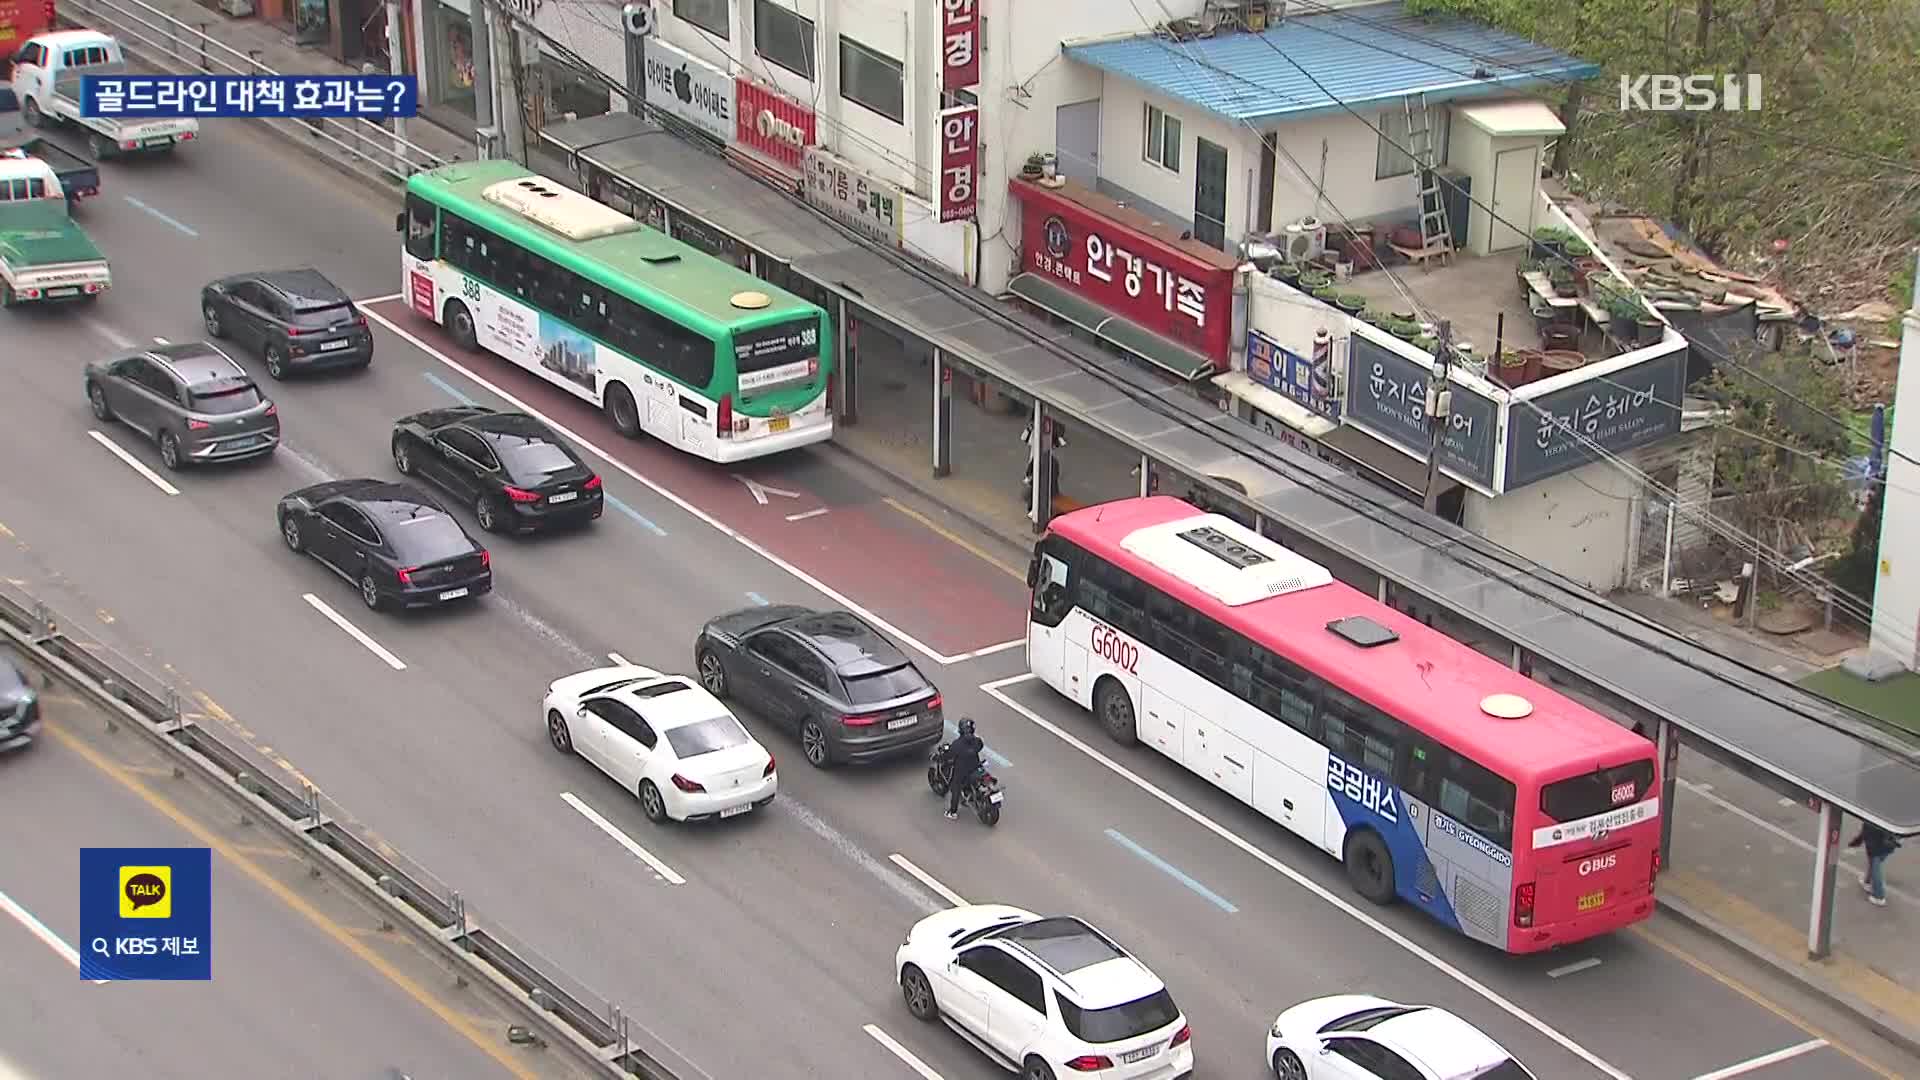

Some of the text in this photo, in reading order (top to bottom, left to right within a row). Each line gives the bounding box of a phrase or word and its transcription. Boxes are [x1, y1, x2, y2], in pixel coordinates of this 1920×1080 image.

[647, 59, 673, 95] 아이폰
[694, 82, 730, 120] 아이패드
[944, 115, 975, 204] 안경
[461, 276, 481, 302] 388
[1086, 233, 1206, 328] 안경가족
[1537, 384, 1656, 449] 윤지승헤어
[1091, 624, 1139, 676] G6002
[1327, 753, 1399, 825] 공공버스
[1611, 782, 1635, 803] G6002
[1434, 814, 1512, 867] 경기도 GYEONGGIDO
